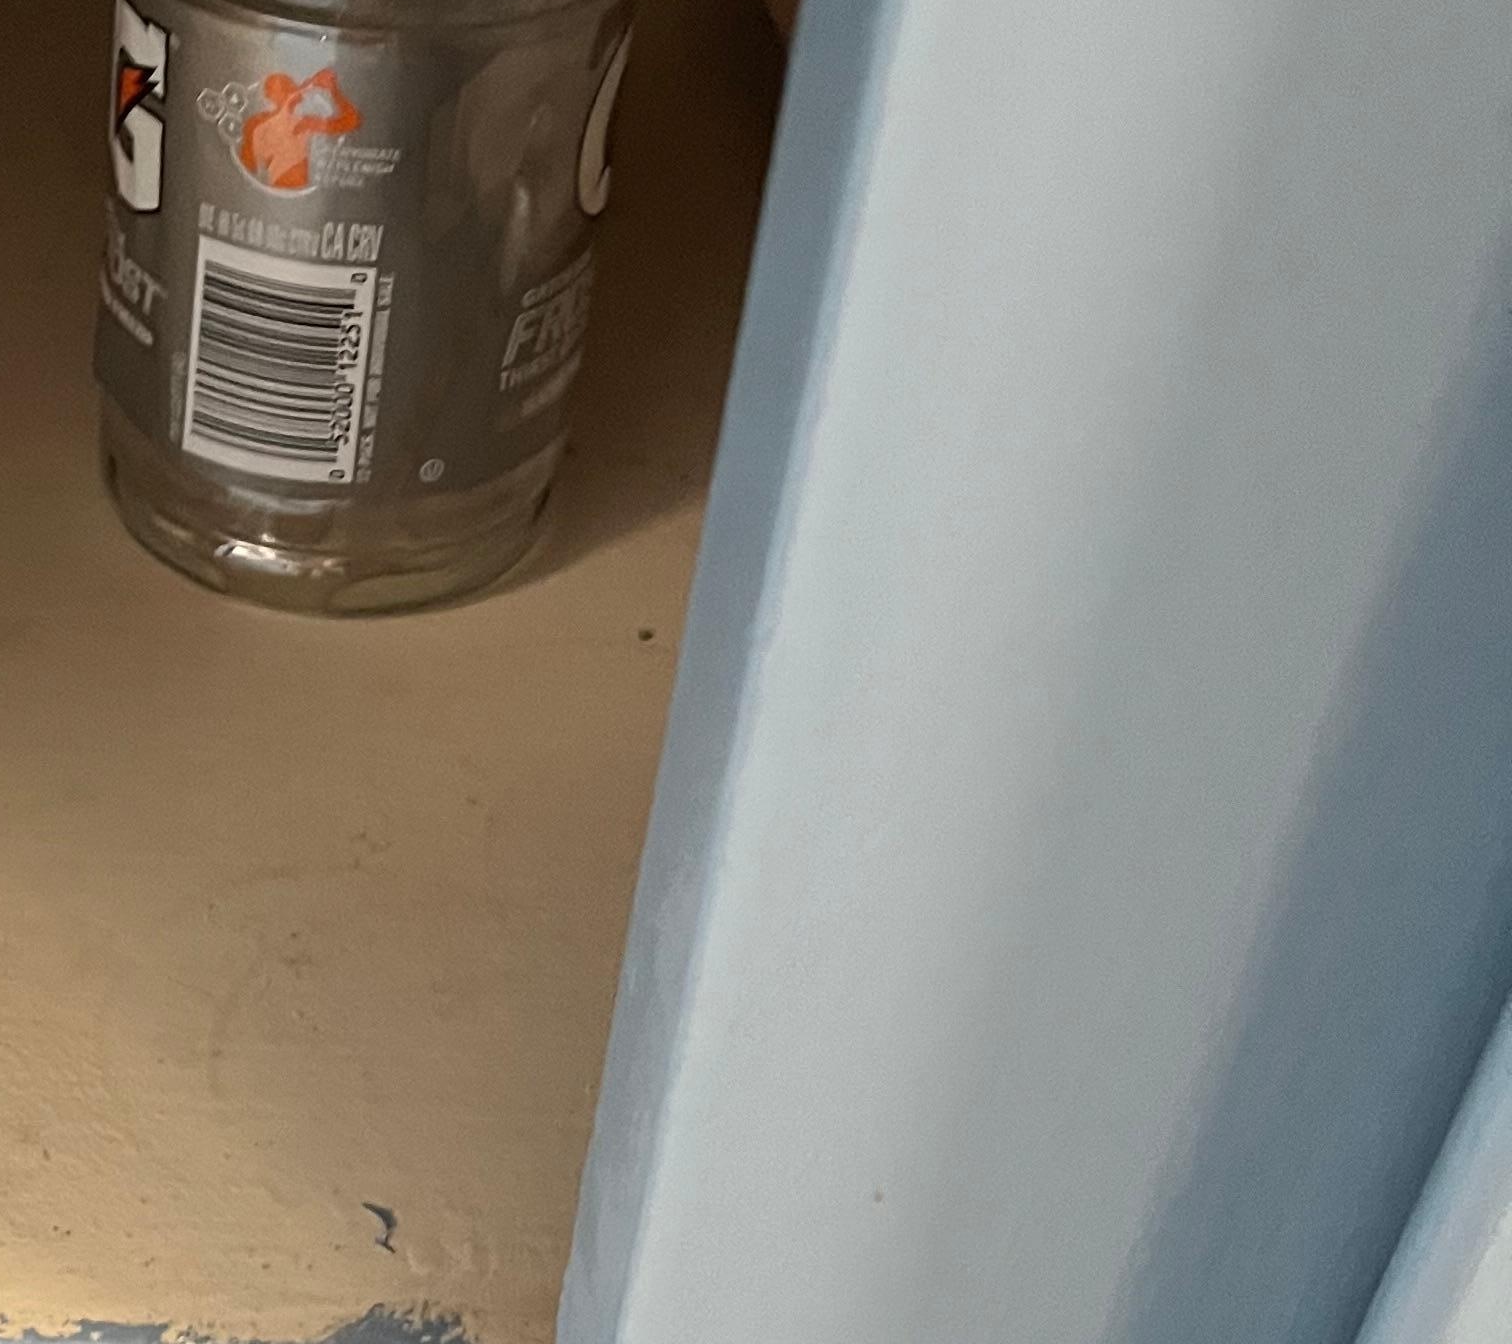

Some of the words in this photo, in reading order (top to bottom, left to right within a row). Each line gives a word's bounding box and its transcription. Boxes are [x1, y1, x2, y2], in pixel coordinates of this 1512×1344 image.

[321, 221, 345, 261] CA
[346, 223, 385, 262] CRV
[350, 272, 368, 284] 0
[338, 311, 363, 370] 12251
[328, 383, 355, 445] 52000
[328, 469, 346, 480] 0
